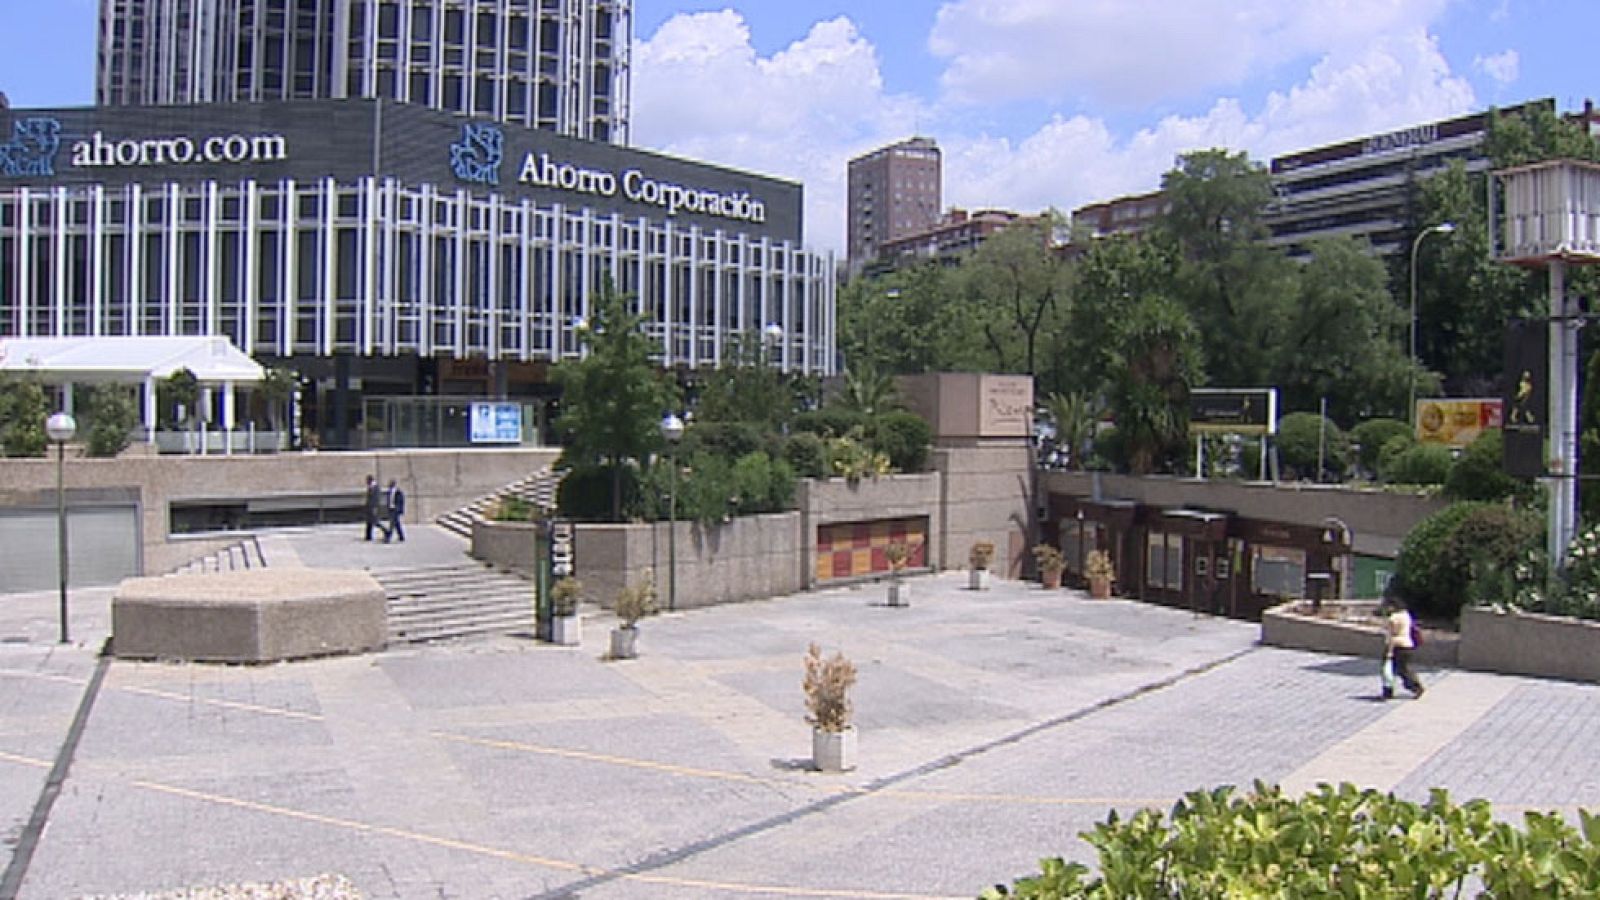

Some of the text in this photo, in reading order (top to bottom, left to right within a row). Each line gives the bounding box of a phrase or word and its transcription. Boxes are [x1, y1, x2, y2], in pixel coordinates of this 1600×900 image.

[71, 130, 287, 168] ahorro.com
[518, 152, 617, 196] Ahorro
[622, 169, 766, 223] Corporación
